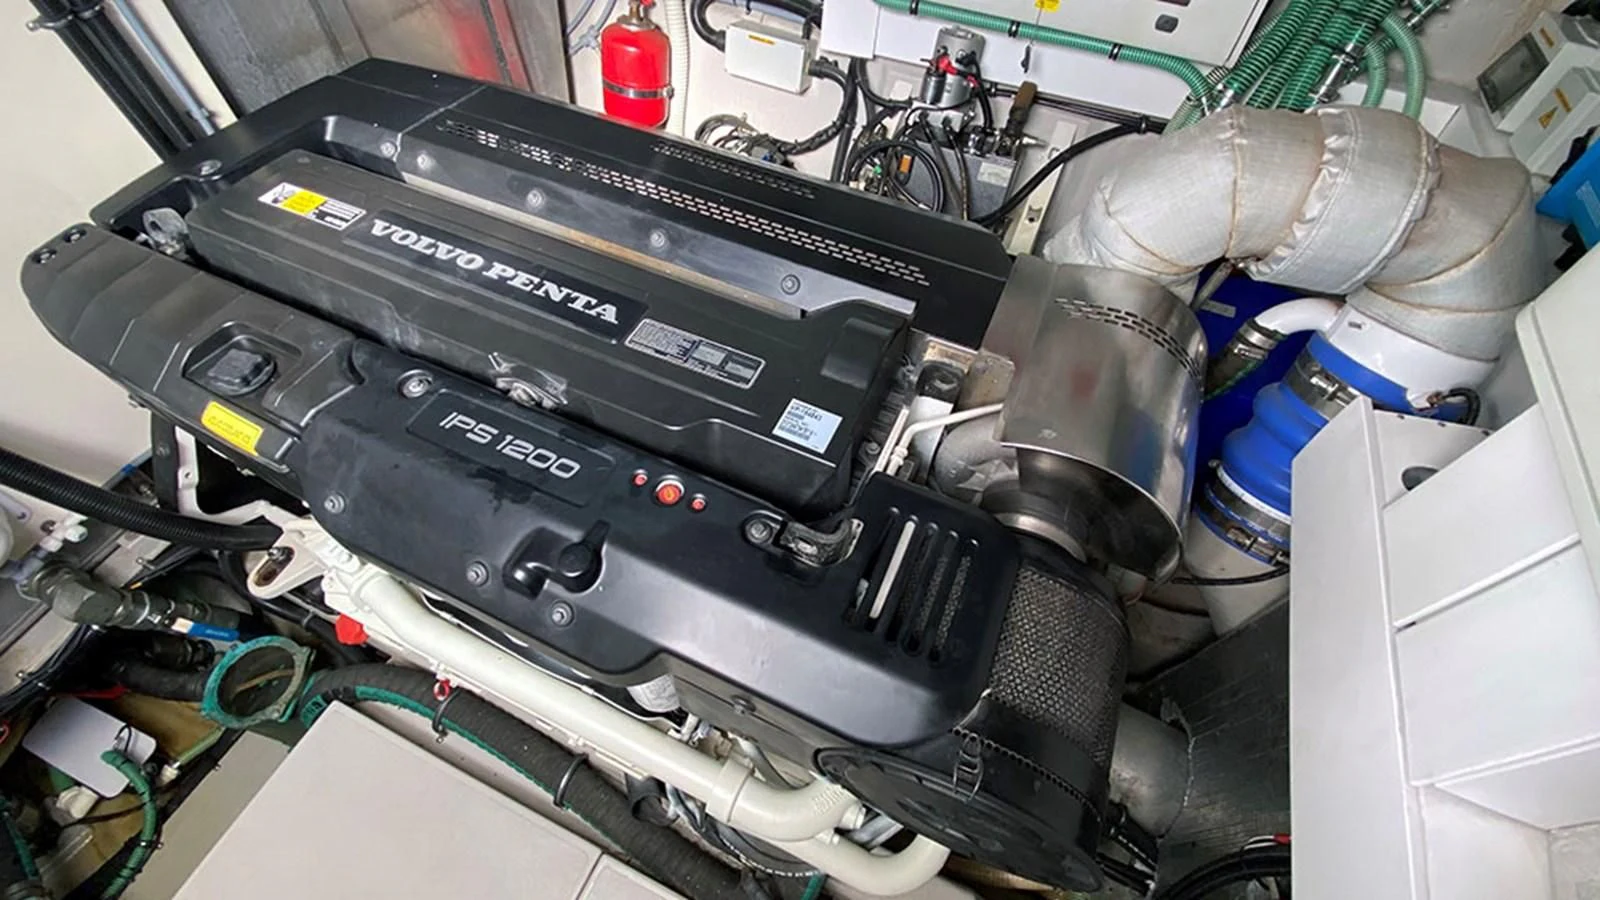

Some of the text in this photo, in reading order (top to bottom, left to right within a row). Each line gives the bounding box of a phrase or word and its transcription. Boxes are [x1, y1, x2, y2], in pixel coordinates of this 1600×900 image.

[367, 218, 620, 325] VOLVO PENTA
[438, 411, 582, 480] IPS 1200
